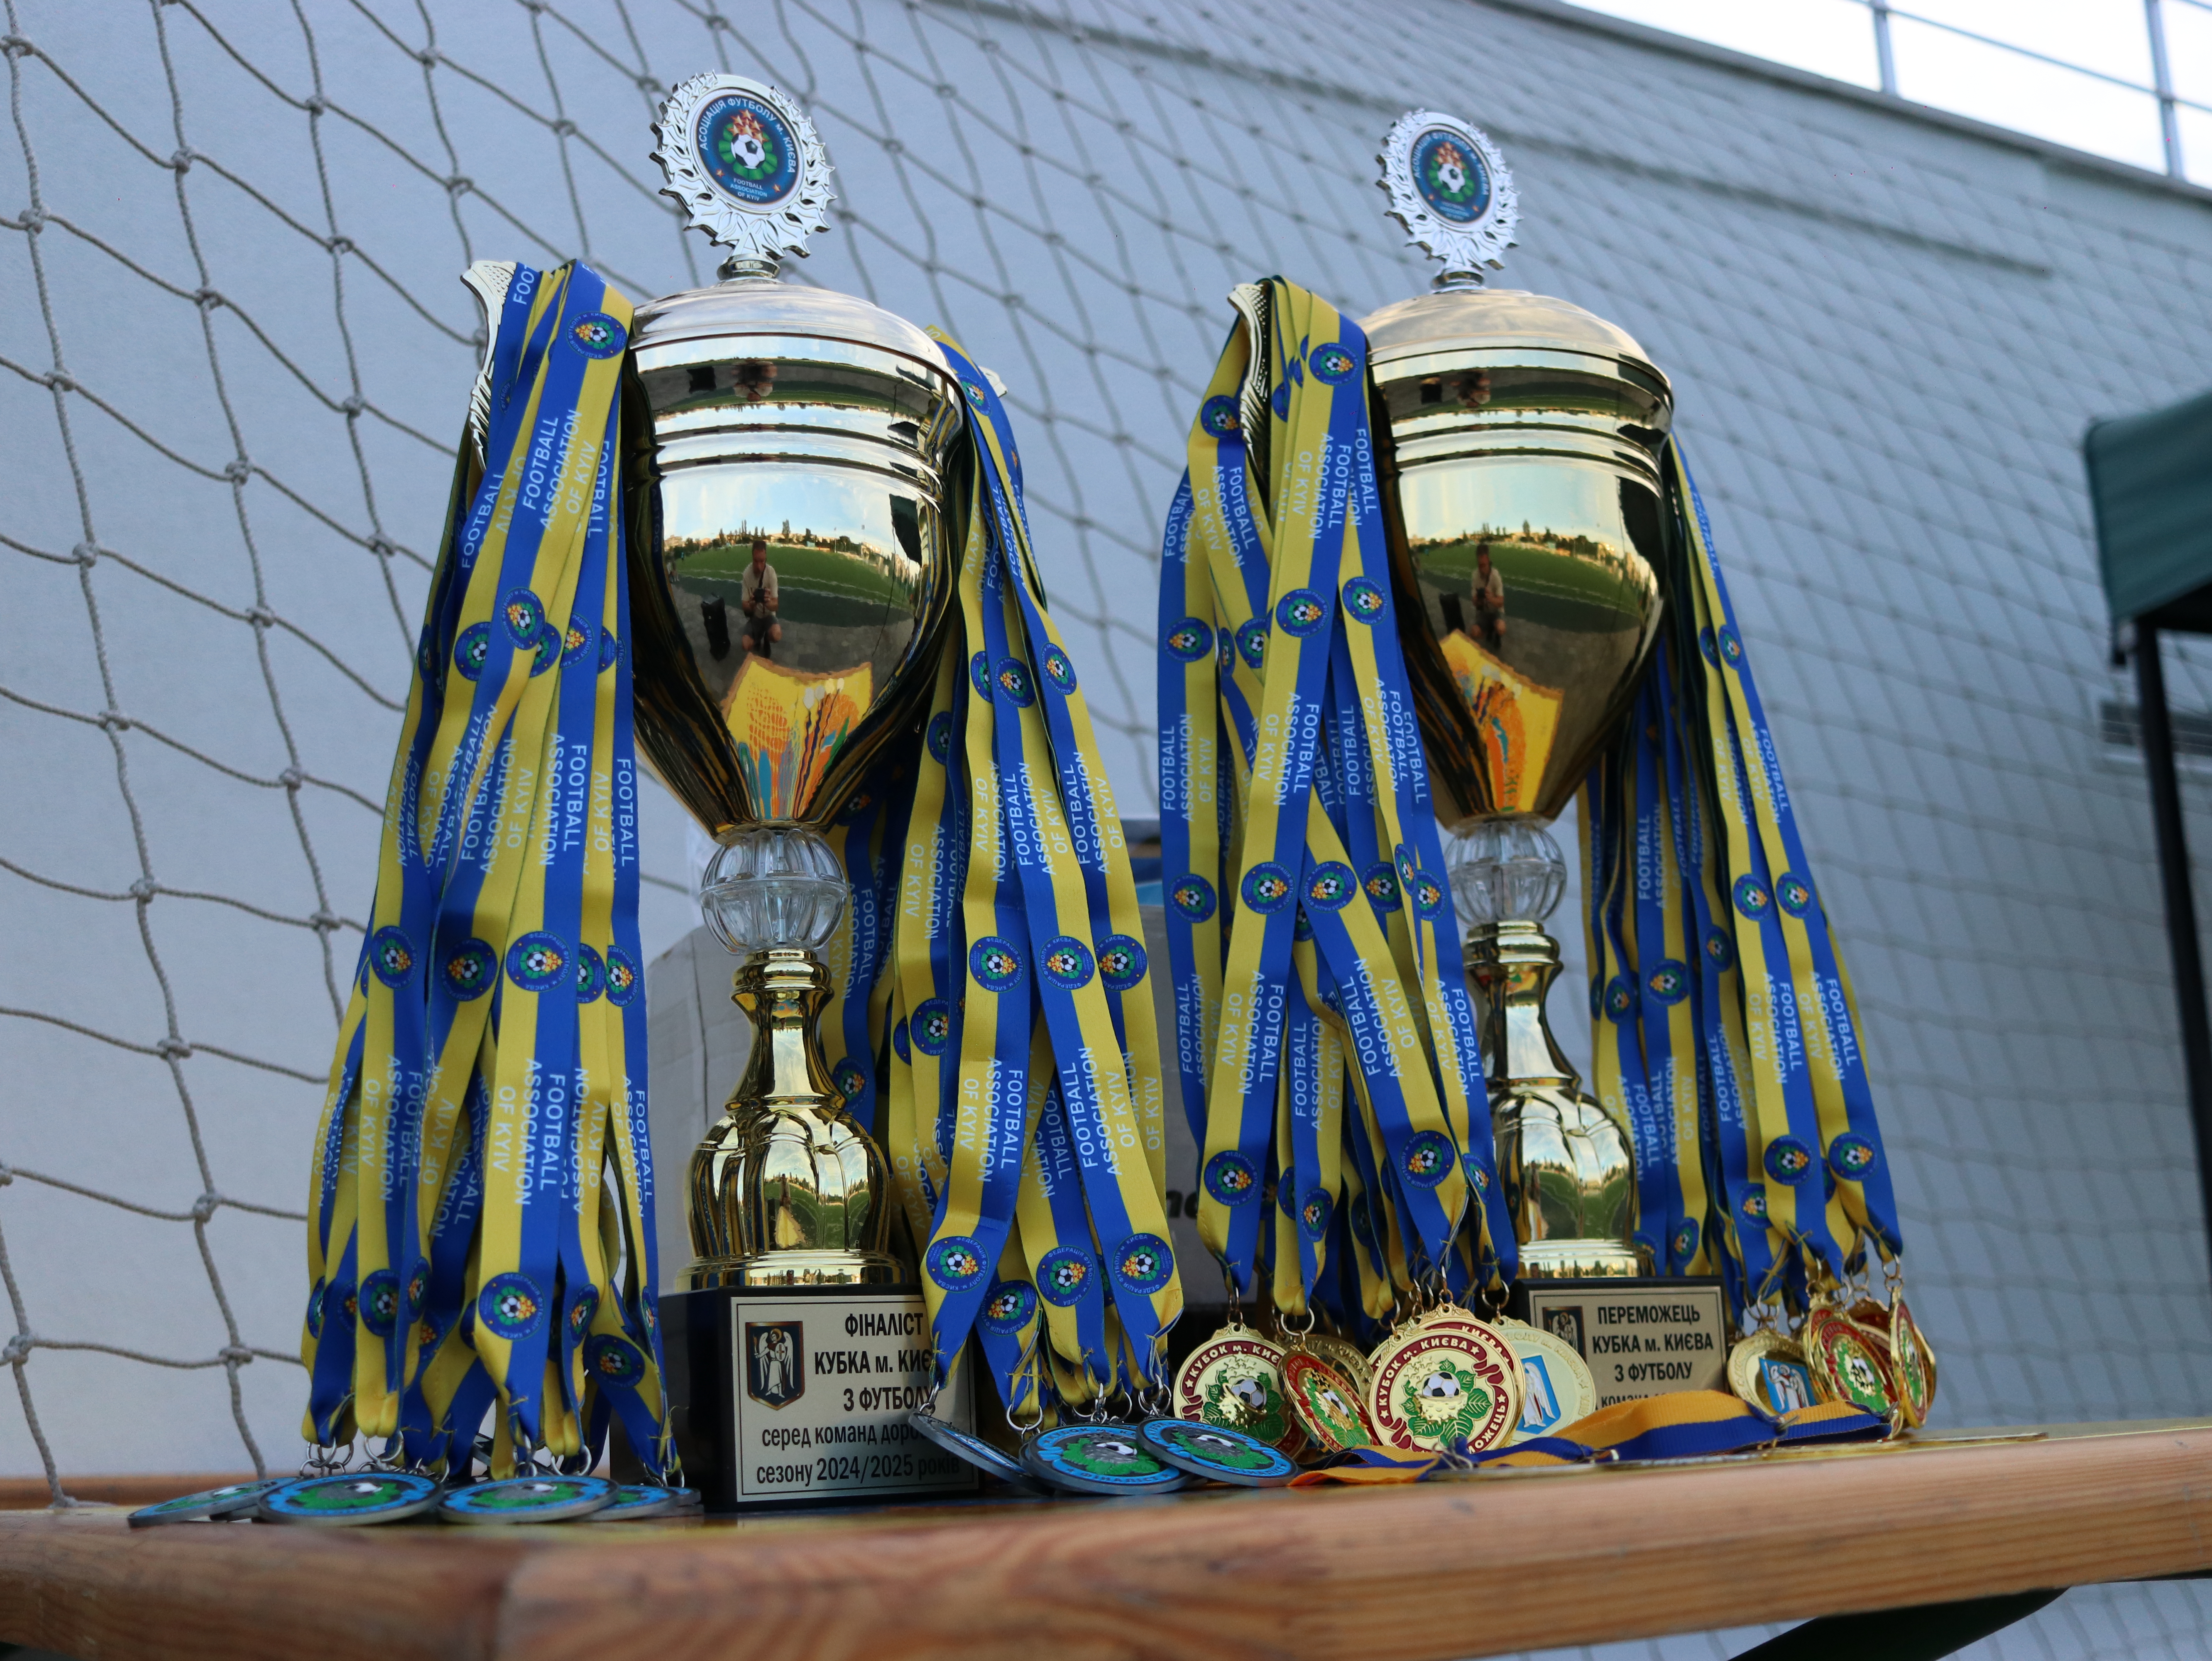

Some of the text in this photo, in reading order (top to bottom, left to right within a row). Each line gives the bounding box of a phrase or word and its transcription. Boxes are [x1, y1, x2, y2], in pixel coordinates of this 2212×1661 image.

[699, 100, 726, 150] АСОЦІАЦІЯ
[727, 97, 777, 121] ФУТБОЛУ
[783, 137, 796, 173] КИЄВА
[730, 184, 767, 197] ASSOCIATION
[734, 178, 763, 190] FOOTBALL
[523, 416, 558, 510] FOOTBALL
[540, 409, 582, 532] ASSOCIATION
[566, 440, 597, 514] OF KYIV
[587, 441, 610, 539] FOOTBALL
[1229, 466, 1256, 549] FOOTBALL
[1308, 433, 1334, 539] ASSOCIATION
[1329, 444, 1351, 528] FOOTBALL
[1356, 428, 1377, 514] FOOTBALL
[461, 473, 509, 568] FOOTBALL
[1212, 465, 1244, 568] ASSOCIATION
[1162, 726, 1175, 810] FOOTBALL
[1181, 714, 1195, 821] ASSOCIATION
[1199, 737, 1212, 802] OF KYIV
[1273, 692, 1301, 805] ASSOCIATION
[1294, 704, 1319, 793] FOOTBALL
[1341, 706, 1361, 796] FOOTBALL
[1374, 677, 1399, 792] ASSOCIATION
[1390, 690, 1408, 781] FOOTBALL
[480, 738, 517, 875] ASSOCIATION
[540, 733, 565, 865] ASSOCIATION
[564, 745, 587, 852] FOOTBALL
[594, 772, 609, 852] OF KYIV
[617, 758, 634, 867] FOOTBALL
[988, 760, 1006, 882] ASSOCIATION
[1005, 773, 1033, 866] FOOTBALL
[1020, 762, 1055, 875] ASSOCIATION
[1044, 789, 1069, 854] OF KYIV
[1064, 763, 1090, 865] FOOTBALL
[1073, 752, 1110, 874] ASSOCIATION
[1094, 777, 1123, 849] OF KYIV
[924, 823, 945, 939] ASSOCIATION
[1638, 815, 1651, 900] FOOTBALL
[858, 889, 877, 984] FOOTBALL
[986, 937, 1019, 955] ФЕДЕРАЦІЯ
[1014, 955, 1023, 984] ФУТБОЛУ
[1048, 975, 1082, 988] ФЕДЕРАЦІЯ
[1342, 976, 1381, 1076] FOOTBALL
[1354, 959, 1403, 1080] ASSOCIATION
[1382, 978, 1415, 1048] OF KYIV
[1779, 982, 1802, 1070] FOOTBALL
[1809, 972, 1845, 1080] ASSOCIATION
[1826, 978, 1857, 1066] FOOTBALL
[1177, 983, 1193, 1073] FOOTBALL
[1238, 971, 1264, 1095] ASSOCIATION
[1259, 984, 1284, 1082] FOOTBALL
[1295, 1022, 1307, 1117] FOOTBALL
[1311, 1013, 1325, 1131] ASSOCIATION
[1434, 979, 1469, 1095] ASSOCIATION
[1452, 988, 1483, 1082] FOOTBALL
[1762, 973, 1787, 1083] ASSOCIATION
[360, 1079, 380, 1166] OF KYIV
[380, 1054, 401, 1202] ASSOCIATION
[399, 1071, 423, 1187] FOOTBALL
[493, 1086, 515, 1171] OF KYIV
[515, 1058, 541, 1204] ASSOCIATION
[541, 1074, 565, 1191] FOOTBALL
[572, 1068, 588, 1215] ASSOCIATION
[622, 1075, 645, 1218] ASSOCIATION
[635, 1090, 651, 1203] FOOTBALL
[959, 1078, 979, 1149] OF KYIV
[977, 1056, 1003, 1182] ASSOCIATION
[1001, 1069, 1023, 1169] FOOTBALL
[1044, 1090, 1072, 1180] FOOTBALL
[1062, 1061, 1098, 1169] FOOTBALL
[1079, 1047, 1123, 1176] ASSOCIATION
[1106, 1071, 1135, 1147] OF KYIV
[1143, 1077, 1160, 1150] OF KYIV
[956, 1237, 986, 1258] ФЕДЕРАЦІЯ
[970, 1259, 987, 1288] ФУТБОЛУ
[1048, 1247, 1084, 1258] ФЕДЕРАЦІЯ
[1084, 1257, 1093, 1288] ФУТБОЛУ
[1114, 1252, 1123, 1282] ФУТБОЛУ
[1126, 1235, 1148, 1245] КИЄВА
[845, 1313, 923, 1337] ФІНАЛІСТ
[938, 1280, 959, 1290] КИЄВА
[1123, 1282, 1160, 1294] ФЕДЕРАЦІЯ
[1598, 1305, 1701, 1325] ПЕРЕМОЖЕЦЬ
[814, 1349, 932, 1375] КУБКА м. КИЄ
[1189, 1345, 1228, 1378] КУБОК
[1252, 1345, 1280, 1364] КИЄ
[1378, 1360, 1402, 1407] КУБОК
[1403, 1349, 1417, 1362] м.
[1420, 1338, 1468, 1351] КИЄВА
[1592, 1333, 1714, 1354] КУБКА м. КИЄВА
[1615, 1362, 1692, 1382] З ФУТБОЛУ
[762, 1428, 811, 1450] серед
[815, 1424, 877, 1445] команд
[844, 1386, 932, 1411] З ФУТБОЛУ
[1047, 1428, 1089, 1440] КУБОК
[1185, 1423, 1237, 1436] КИЄВА
[756, 1452, 960, 1486] сезону 2024/2025 років
[1081, 1472, 1158, 1482] ФІНАЛІСТ
[1229, 1463, 1284, 1476] ФІНАЛІСТ
